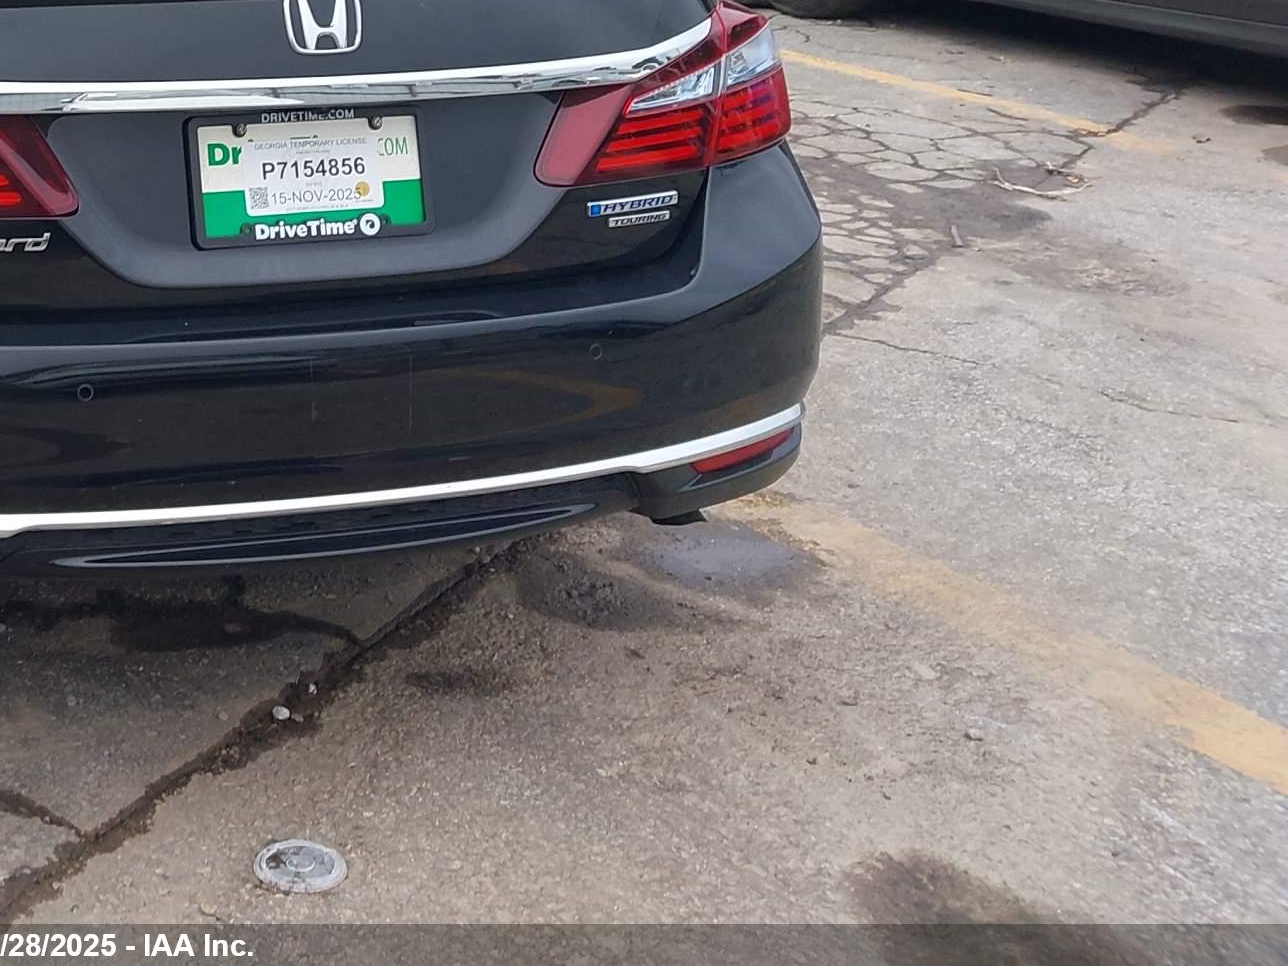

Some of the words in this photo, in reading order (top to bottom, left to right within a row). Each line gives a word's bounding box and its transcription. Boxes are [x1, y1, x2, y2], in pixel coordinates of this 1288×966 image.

[261, 109, 355, 123] DRIVETIME.COM
[254, 141, 288, 151] GEORGIA
[289, 139, 335, 149] TEMPORARY
[335, 137, 367, 146] LICENSE
[261, 157, 366, 180] P7154856
[603, 195, 672, 213] HYBRID
[613, 213, 666, 226] TOURING
[255, 216, 355, 240] DriveTime
